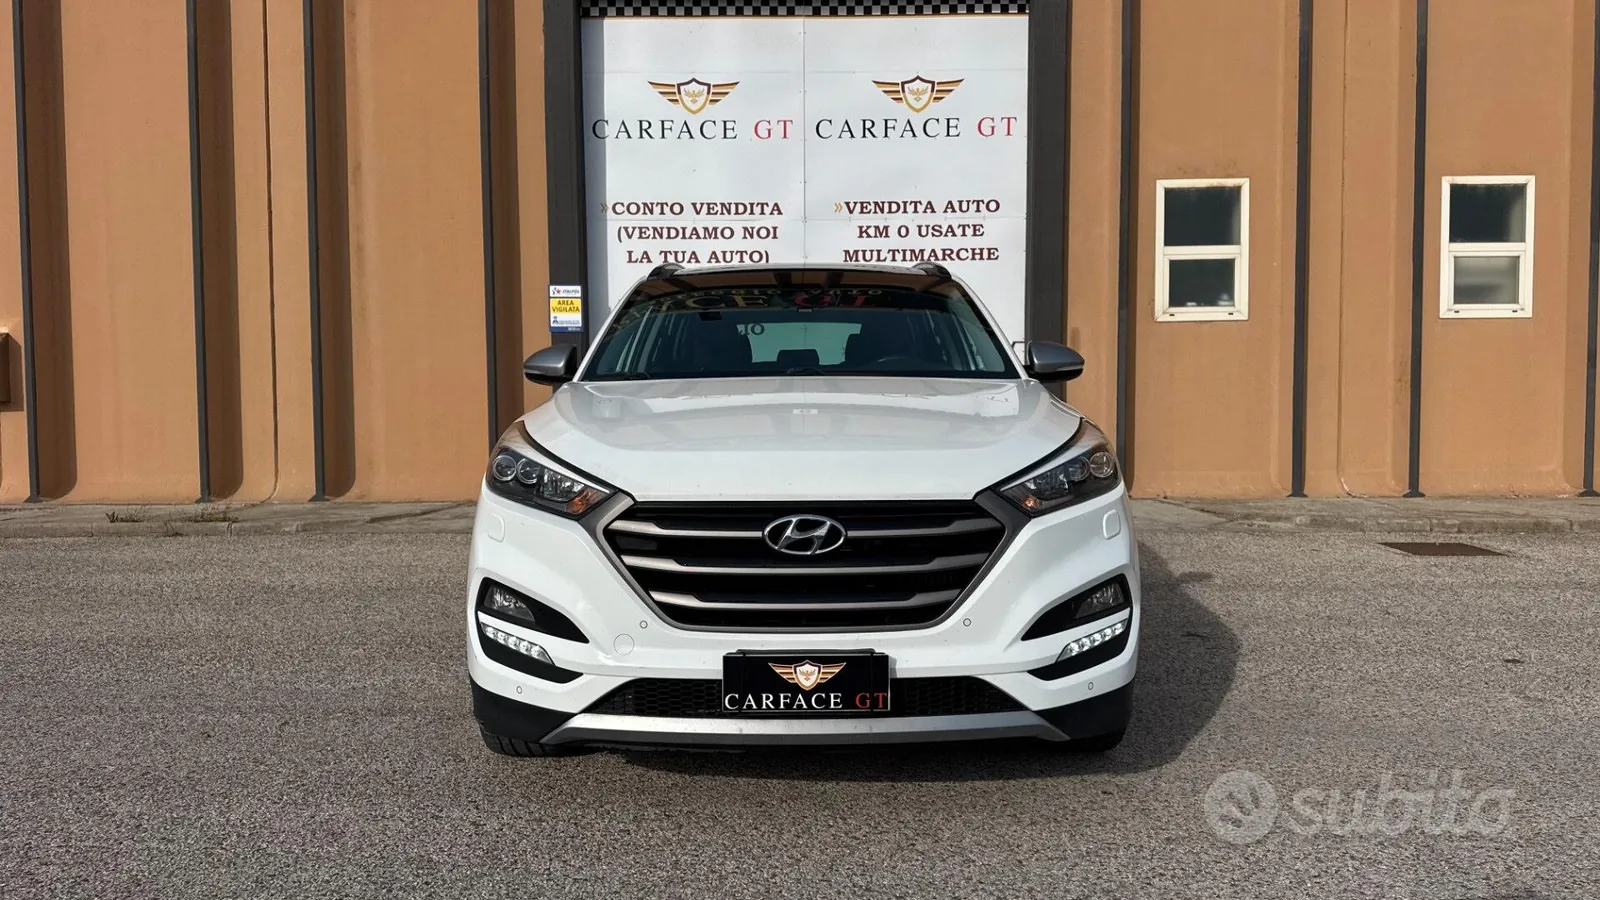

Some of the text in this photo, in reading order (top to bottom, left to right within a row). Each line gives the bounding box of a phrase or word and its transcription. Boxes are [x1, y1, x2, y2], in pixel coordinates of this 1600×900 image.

[592, 119, 794, 140] CARFACE GT
[815, 116, 1018, 139] CARFACE GT
[611, 202, 783, 215] CONTO VENDITA
[844, 199, 1001, 214] VENDITA AUTO
[617, 226, 779, 243] (VENDIAMO NOI
[857, 225, 890, 238] KM
[916, 224, 985, 238] USATE
[626, 250, 770, 264] LA TUA AUTO)
[843, 247, 1000, 263] MULTIMARCHE
[724, 693, 888, 710] CARFACE GT
